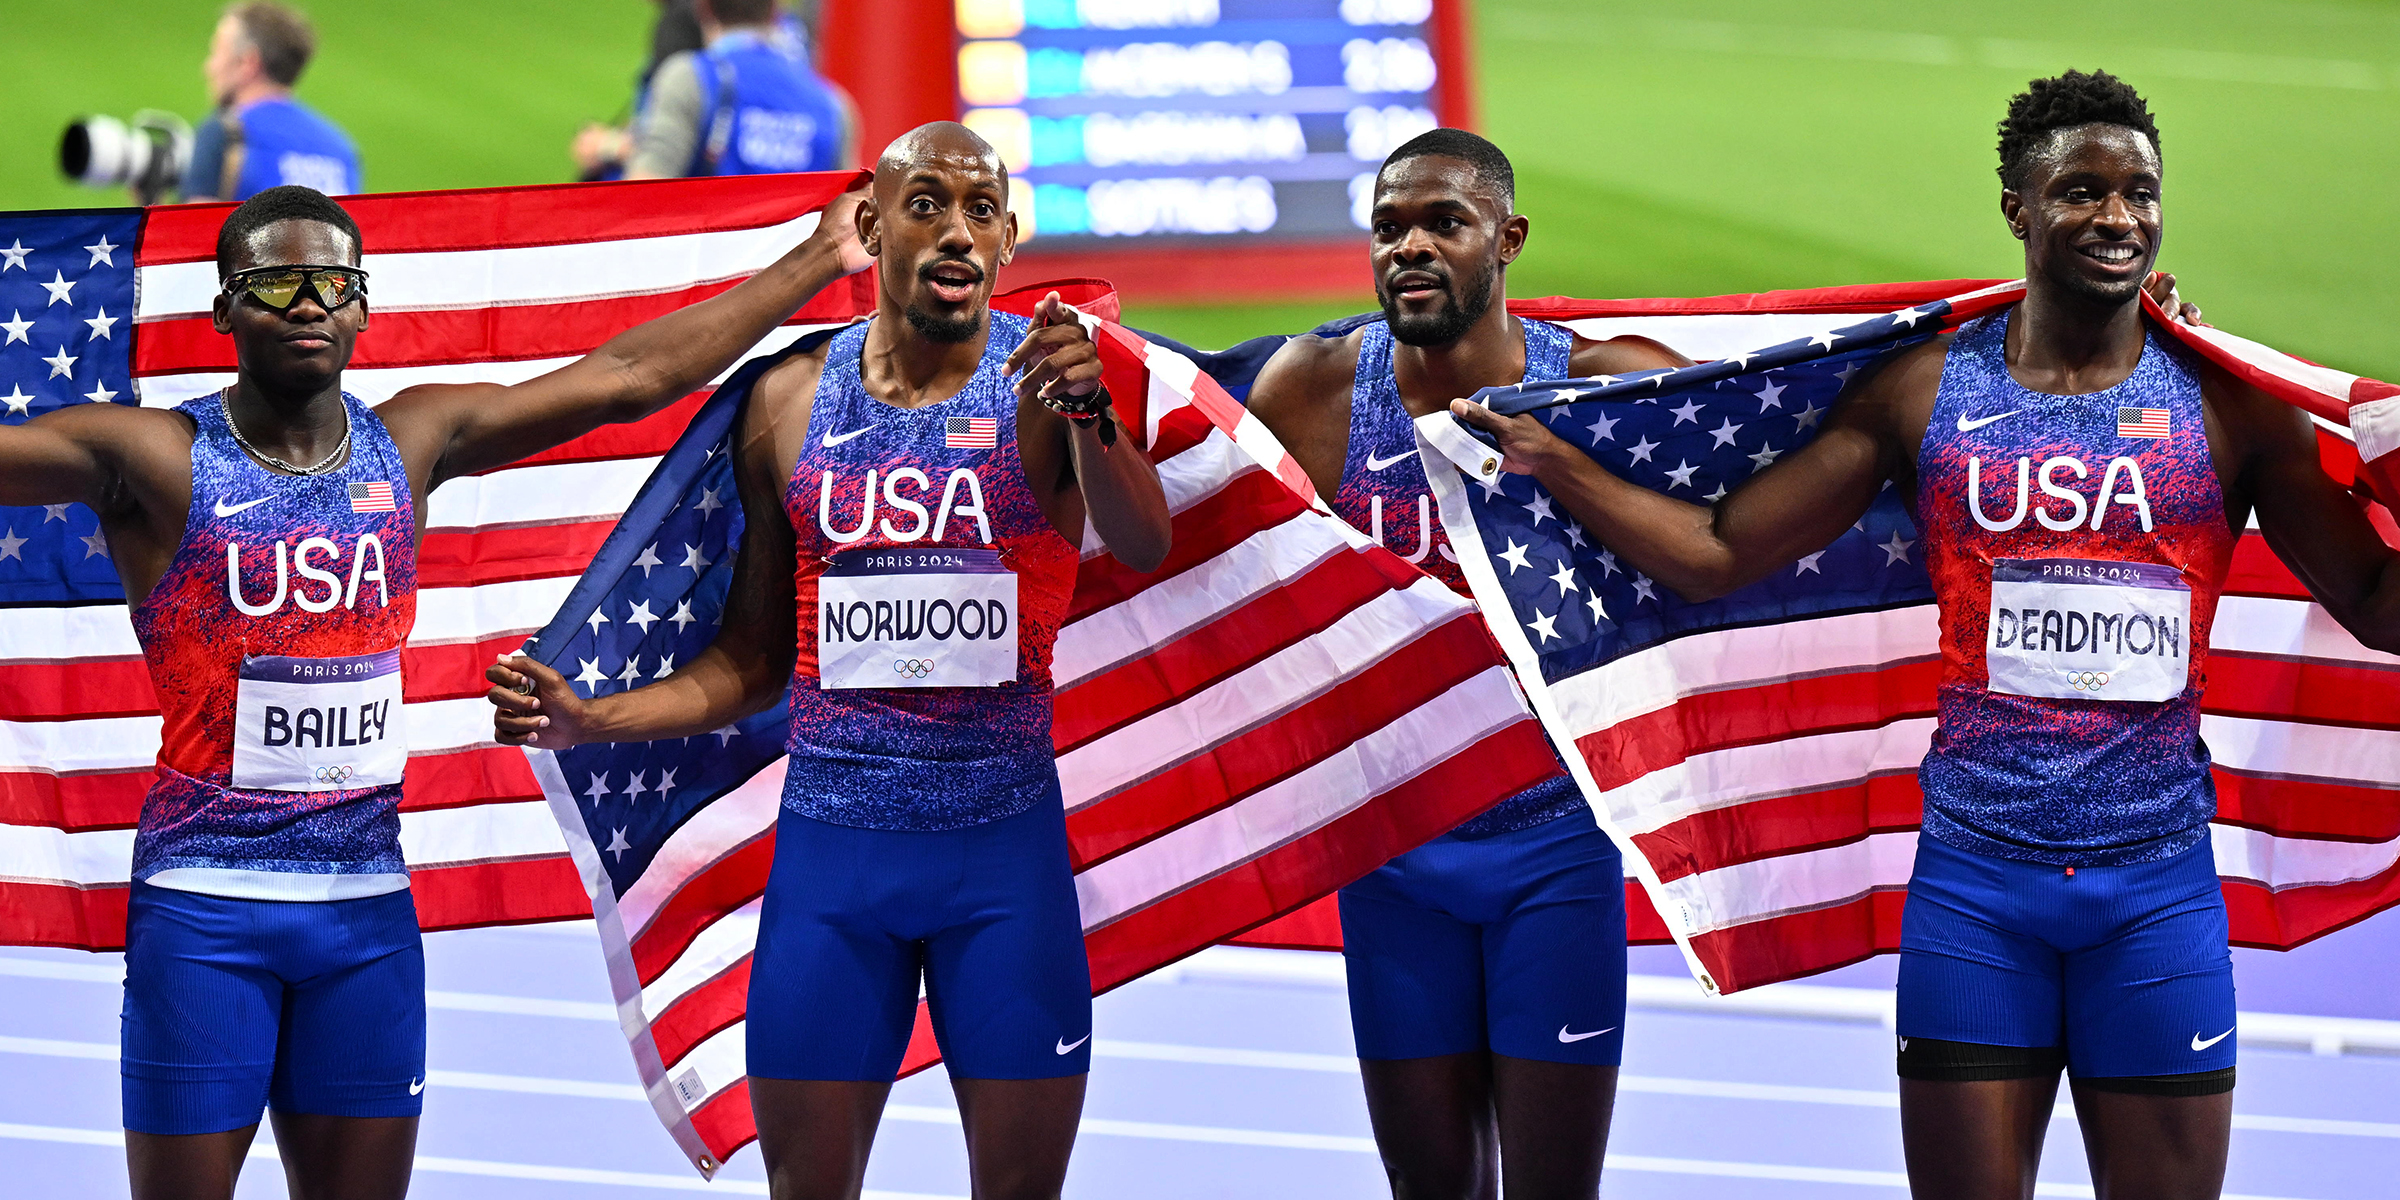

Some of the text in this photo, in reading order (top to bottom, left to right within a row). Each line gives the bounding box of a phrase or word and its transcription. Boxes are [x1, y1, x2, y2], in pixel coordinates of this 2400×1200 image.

[819, 467, 993, 544] USA
[1968, 456, 2153, 533] USA
[227, 533, 389, 617] USA
[919, 555, 963, 567] 2024
[2098, 568, 2141, 581] 2024
[825, 598, 1008, 643] NORWOOD
[1995, 608, 2180, 658] DEADMON
[344, 661, 374, 675] 2024
[264, 698, 389, 748] BAILEY
